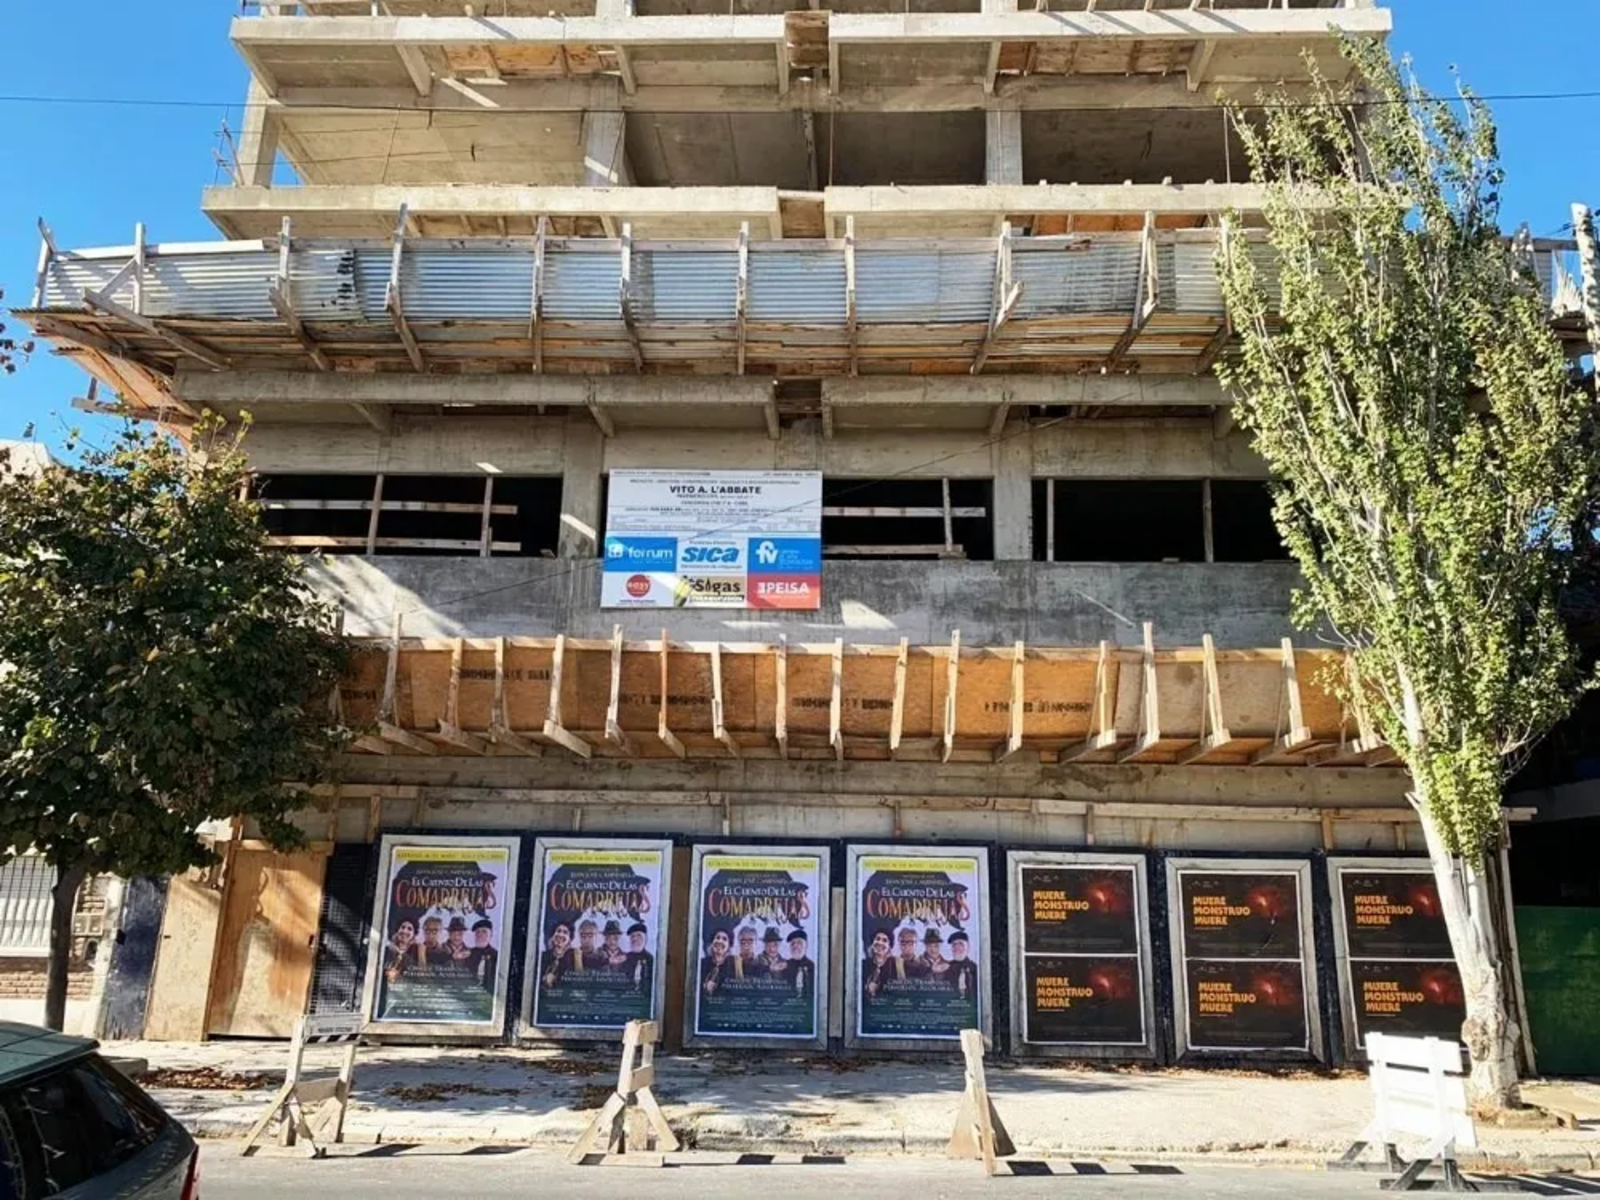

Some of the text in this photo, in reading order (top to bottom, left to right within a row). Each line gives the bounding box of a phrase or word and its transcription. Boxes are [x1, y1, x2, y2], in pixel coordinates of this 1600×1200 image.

[670, 486, 762, 494] VITO A. L'ABBATE
[627, 546, 673, 558] ferrum
[766, 582, 810, 594] PEISA
[1033, 890, 1066, 900] MUERE
[1193, 896, 1226, 904] MUERE
[1354, 896, 1389, 904] MUERE
[1034, 901, 1090, 910] MONSTRUO
[1355, 906, 1414, 914] MONSTRUO
[1034, 911, 1066, 920] MUERE
[1193, 906, 1250, 916] MONSTRUO
[1194, 916, 1228, 926] MUERE
[1356, 916, 1391, 924] MUERE
[1036, 977, 1070, 986] MUERE
[1363, 982, 1399, 990] MUERE
[1198, 982, 1232, 992] MUERE
[1036, 987, 1094, 997] MONSTRUO
[1199, 993, 1256, 1002] MONSTRUO
[1364, 992, 1424, 1002] MONSTRUO
[1037, 998, 1071, 1007] MUERE
[1200, 1003, 1233, 1012] MUERE
[1366, 1003, 1400, 1012] MUERE
